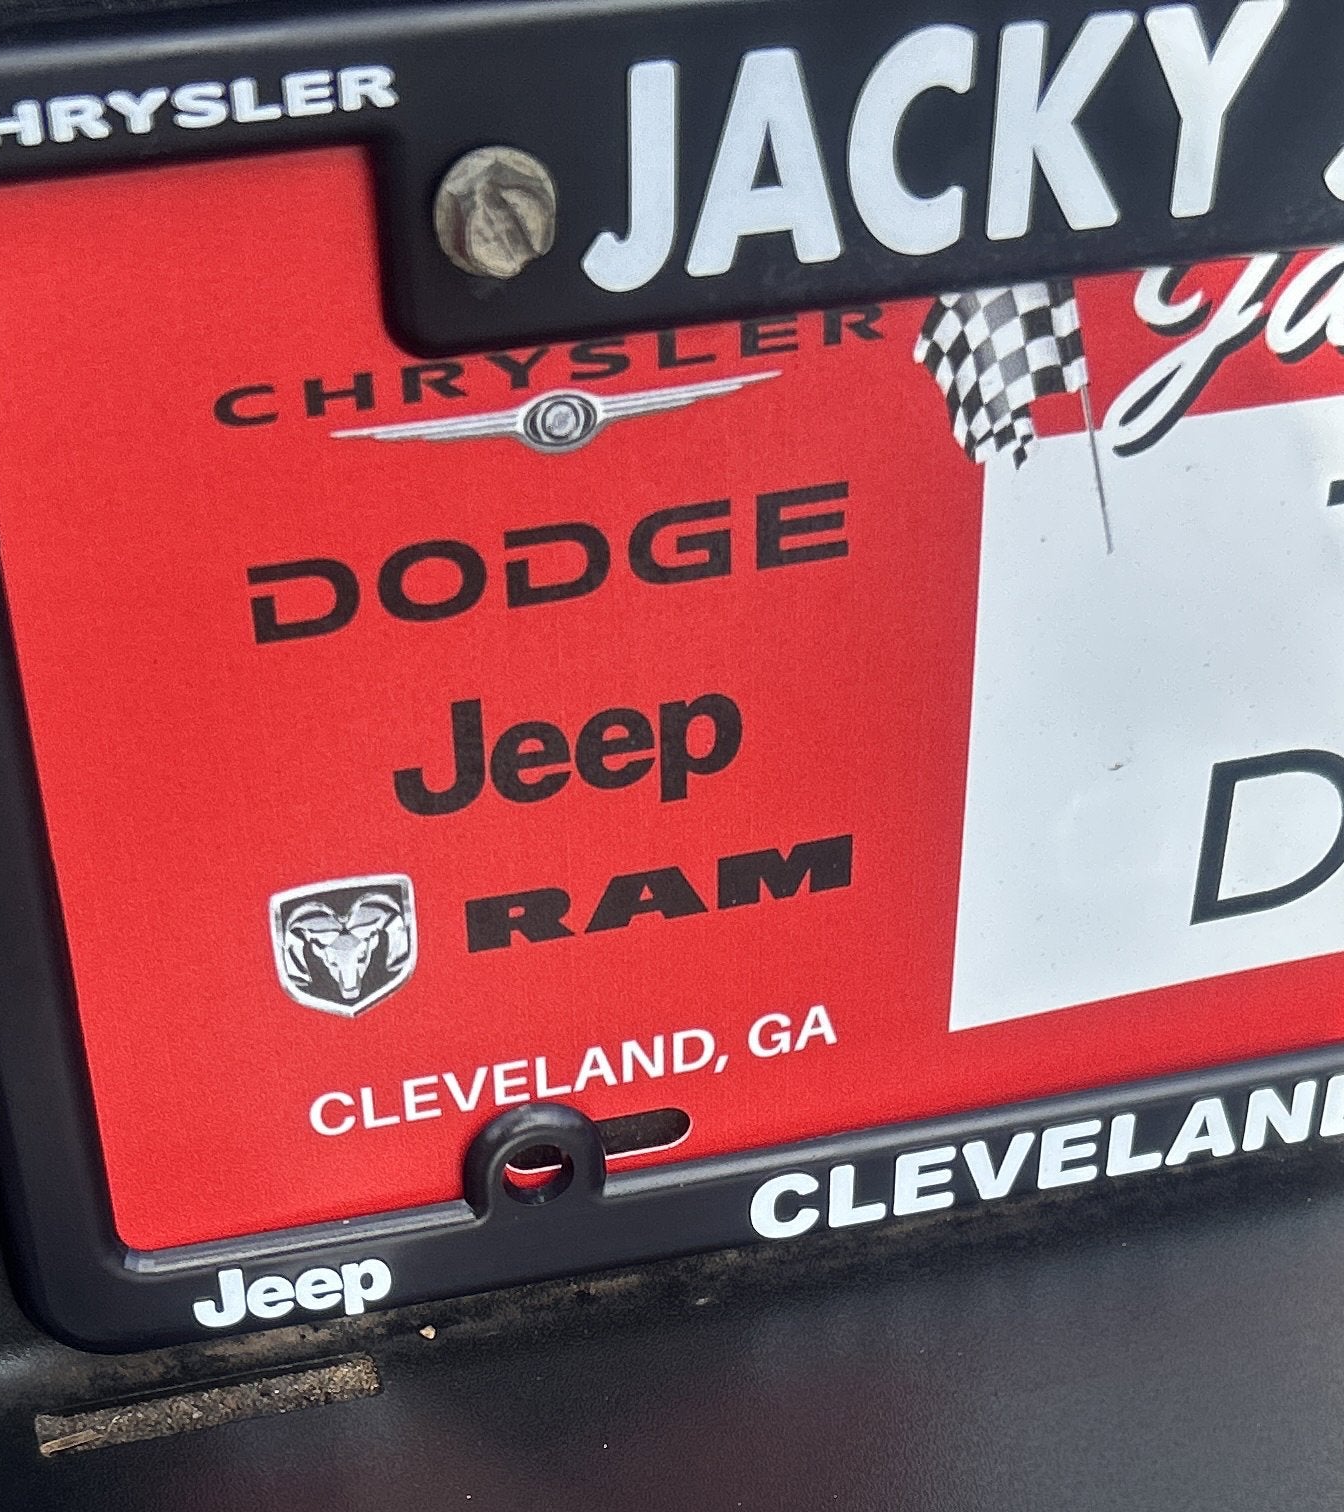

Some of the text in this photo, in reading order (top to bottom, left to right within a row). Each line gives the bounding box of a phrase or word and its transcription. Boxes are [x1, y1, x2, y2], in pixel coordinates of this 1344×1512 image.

[581, 0, 1288, 292] JACKY
[213, 303, 884, 430] CHRYSLER
[247, 481, 850, 645] DODGE
[393, 693, 743, 816] Jeep
[465, 835, 854, 953] RAM
[309, 1004, 838, 1137] CLEVELAND, GA
[192, 1258, 393, 1329] Jeep
